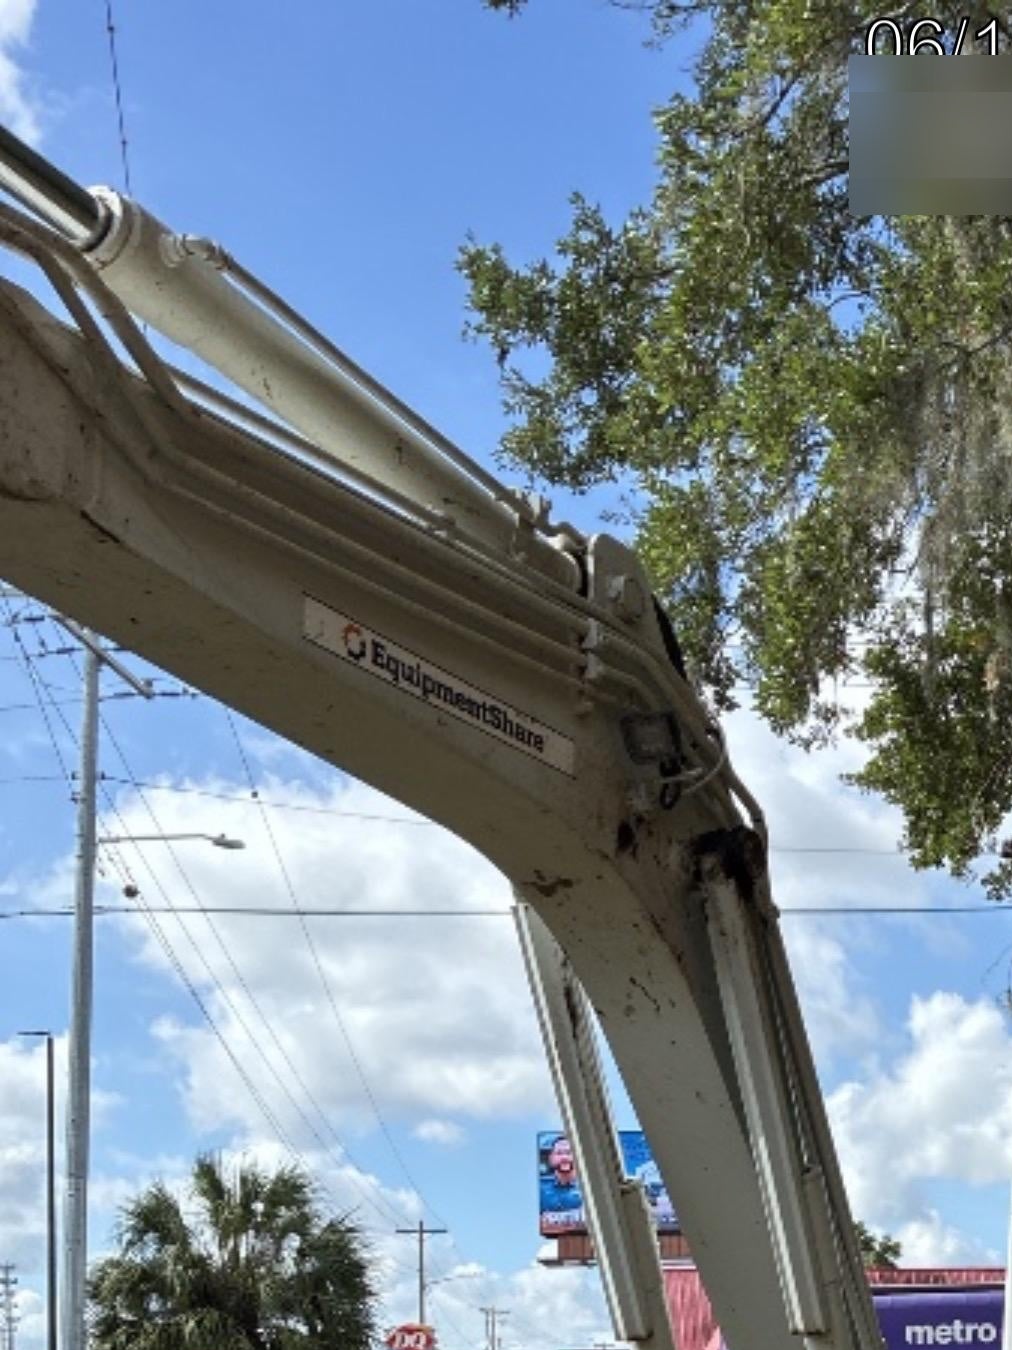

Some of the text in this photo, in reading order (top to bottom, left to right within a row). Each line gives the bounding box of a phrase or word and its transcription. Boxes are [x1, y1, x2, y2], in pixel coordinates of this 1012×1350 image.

[371, 638, 545, 753] EquipmentShare
[393, 1331, 427, 1350] DQ
[905, 1319, 997, 1344] metro
